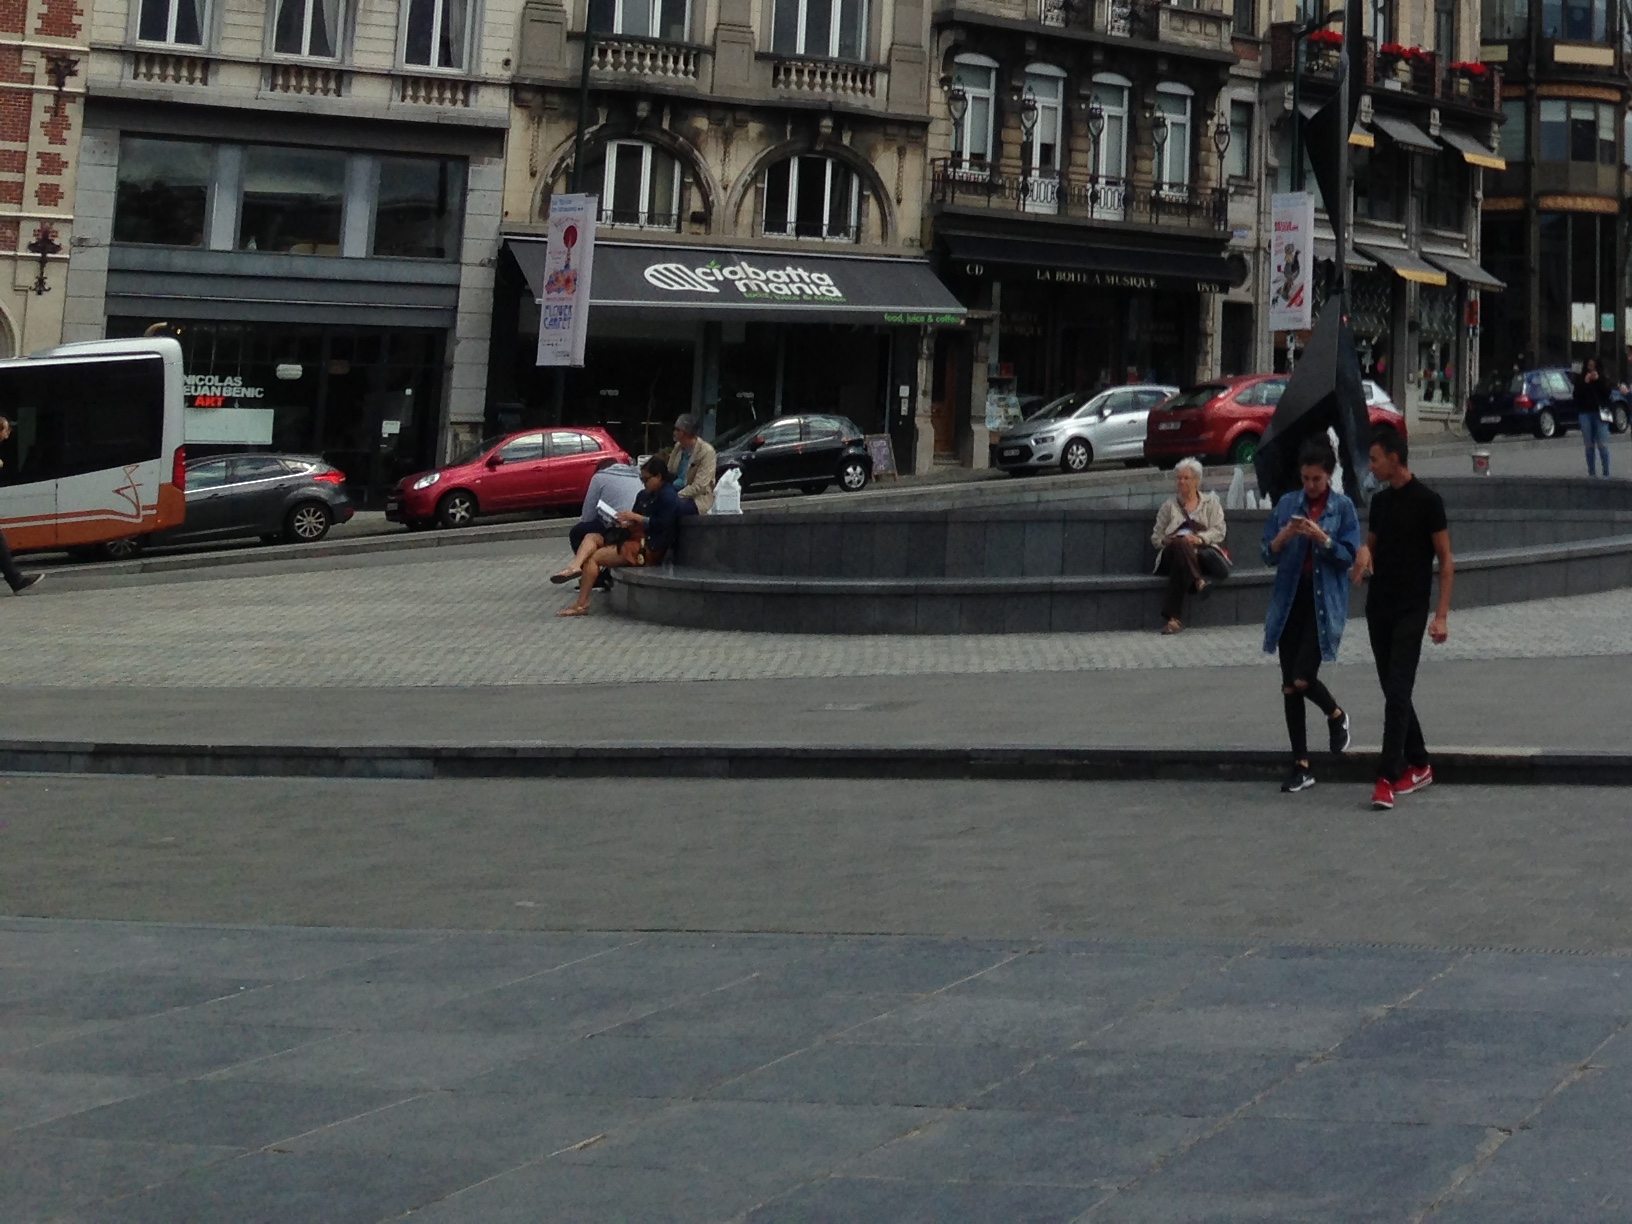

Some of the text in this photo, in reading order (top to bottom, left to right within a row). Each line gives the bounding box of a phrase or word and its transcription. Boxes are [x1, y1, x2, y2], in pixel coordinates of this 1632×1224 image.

[694, 261, 835, 286] ciabatta
[966, 264, 984, 276] CD
[1037, 269, 1051, 281] LA
[1105, 275, 1158, 289] MUSIQUE
[734, 279, 843, 298] mania
[1196, 282, 1220, 293] DVD
[183, 374, 243, 387] NICOLAS
[194, 396, 225, 407] ART
